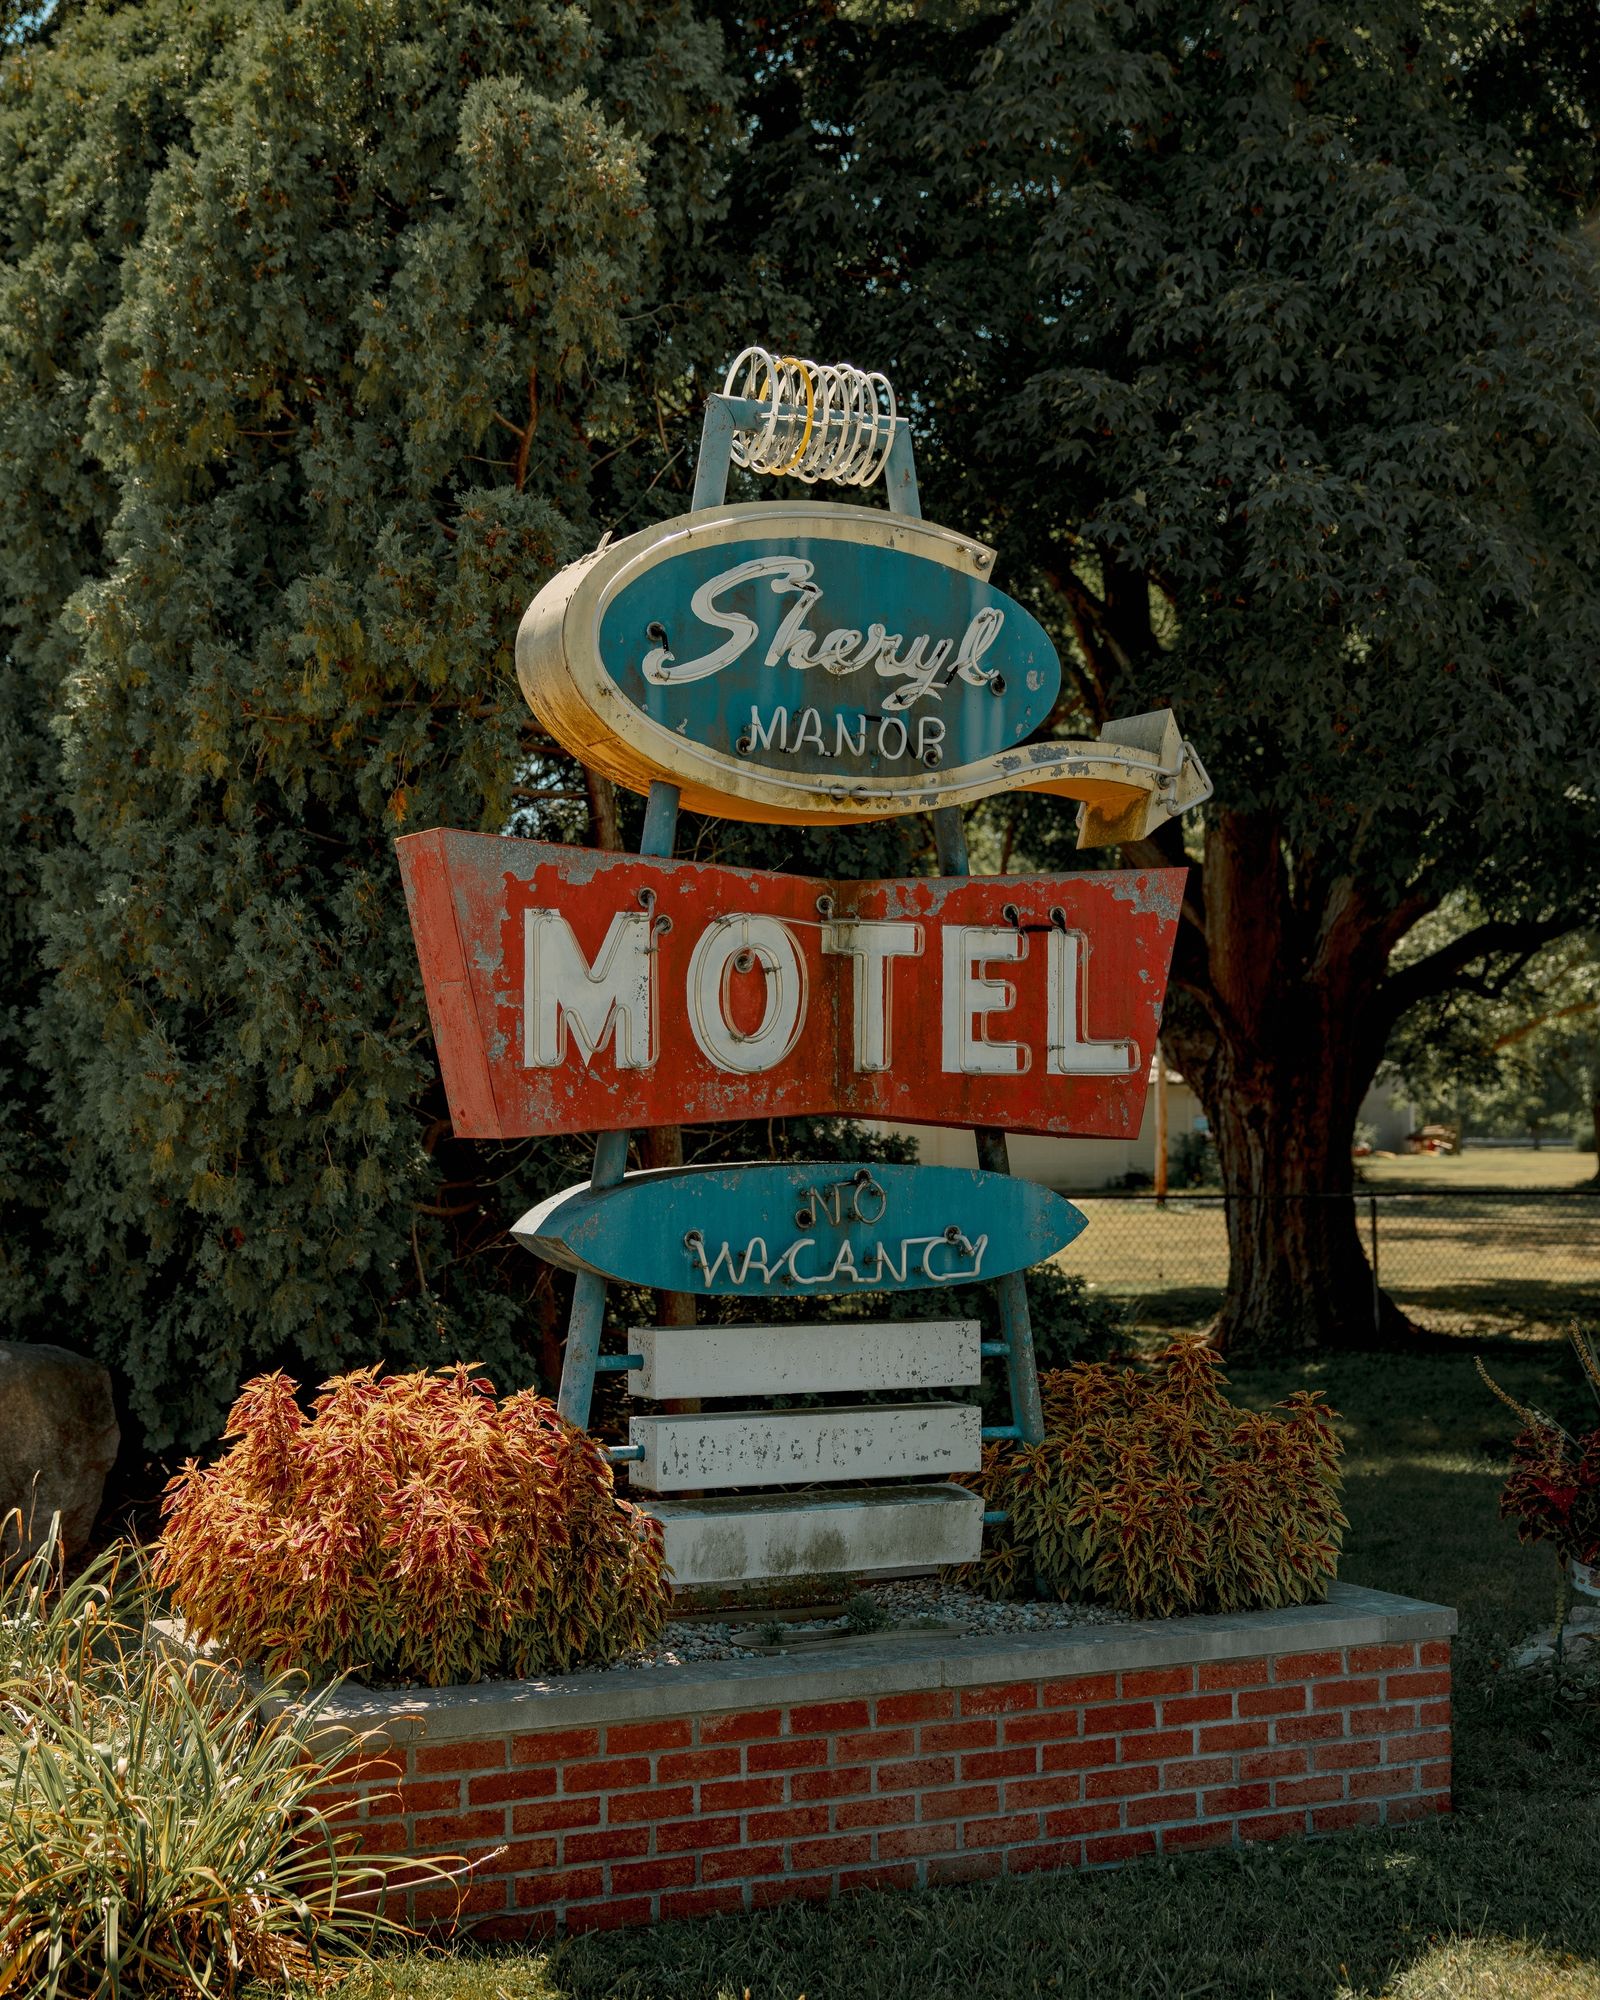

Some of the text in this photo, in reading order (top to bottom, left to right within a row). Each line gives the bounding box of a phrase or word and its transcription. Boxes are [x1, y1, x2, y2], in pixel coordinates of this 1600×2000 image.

[641, 555, 1005, 711] Sheryl
[748, 704, 947, 761] MANOR
[523, 908, 1141, 1076] MOTEL
[808, 1180, 886, 1225] NO
[690, 1234, 988, 1288] VACANCY
